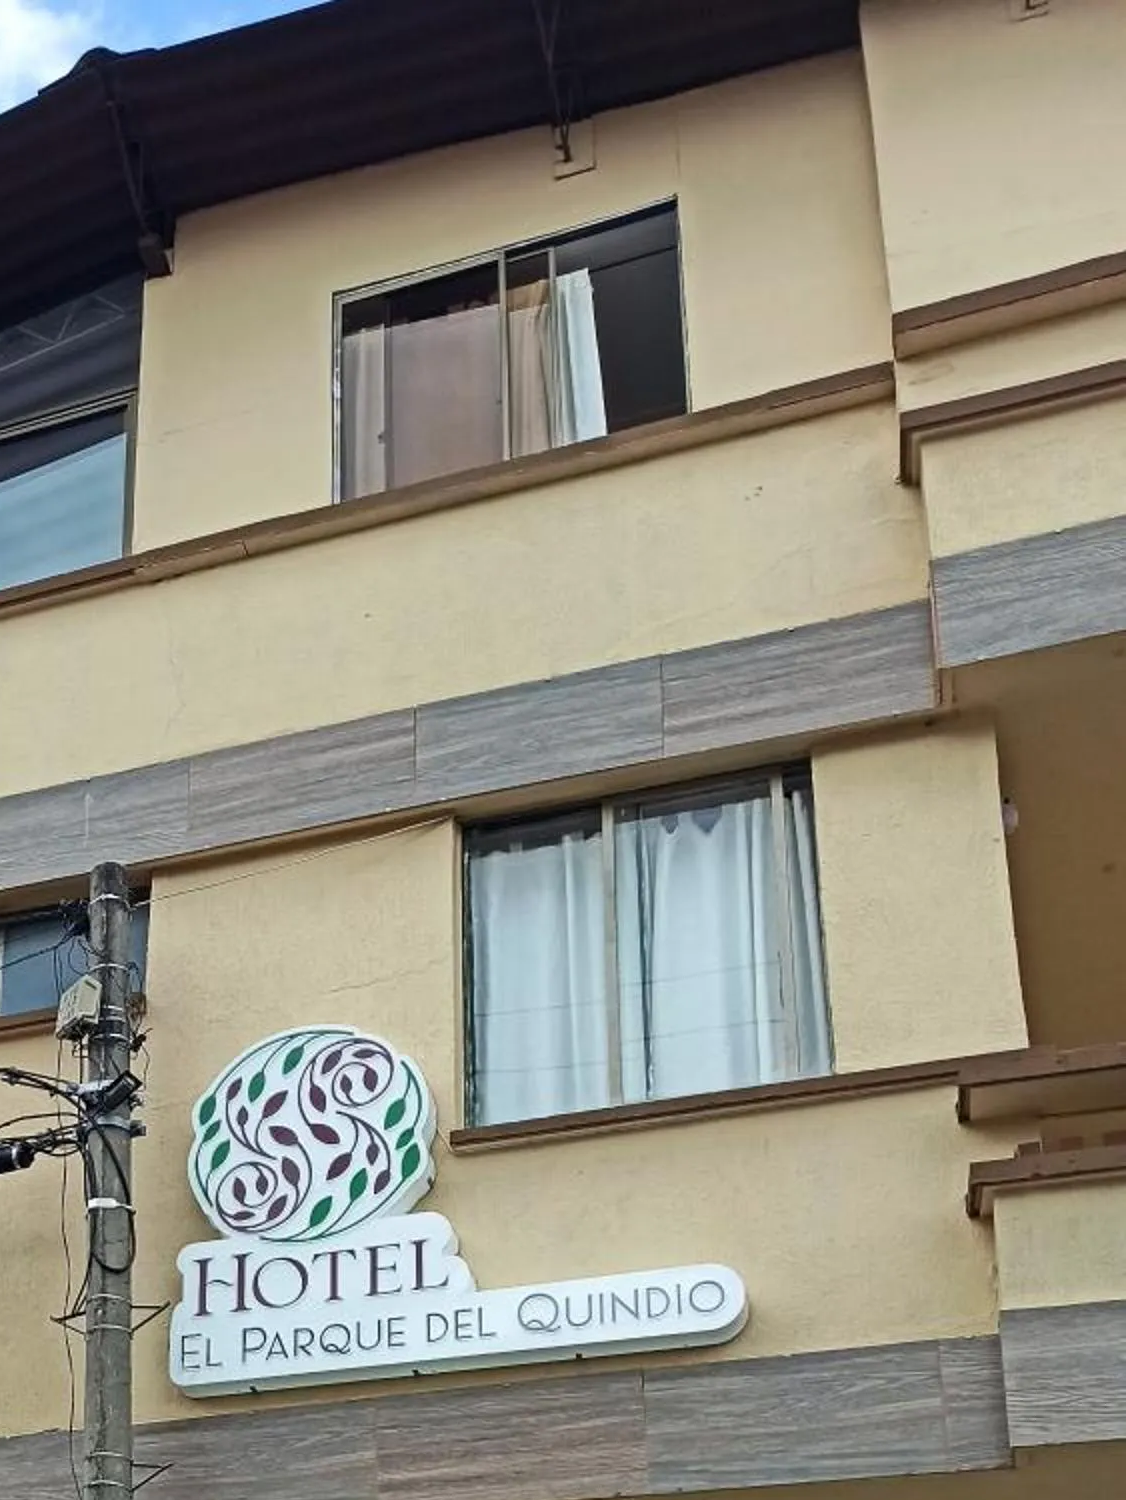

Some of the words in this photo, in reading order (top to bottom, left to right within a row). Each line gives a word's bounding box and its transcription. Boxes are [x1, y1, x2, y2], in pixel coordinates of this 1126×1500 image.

[193, 1239, 449, 1317] HOTEL
[181, 1332, 222, 1370] EL
[241, 1316, 407, 1364] PARQUE
[426, 1306, 496, 1343] DEL
[517, 1280, 725, 1333] QUINDIO
